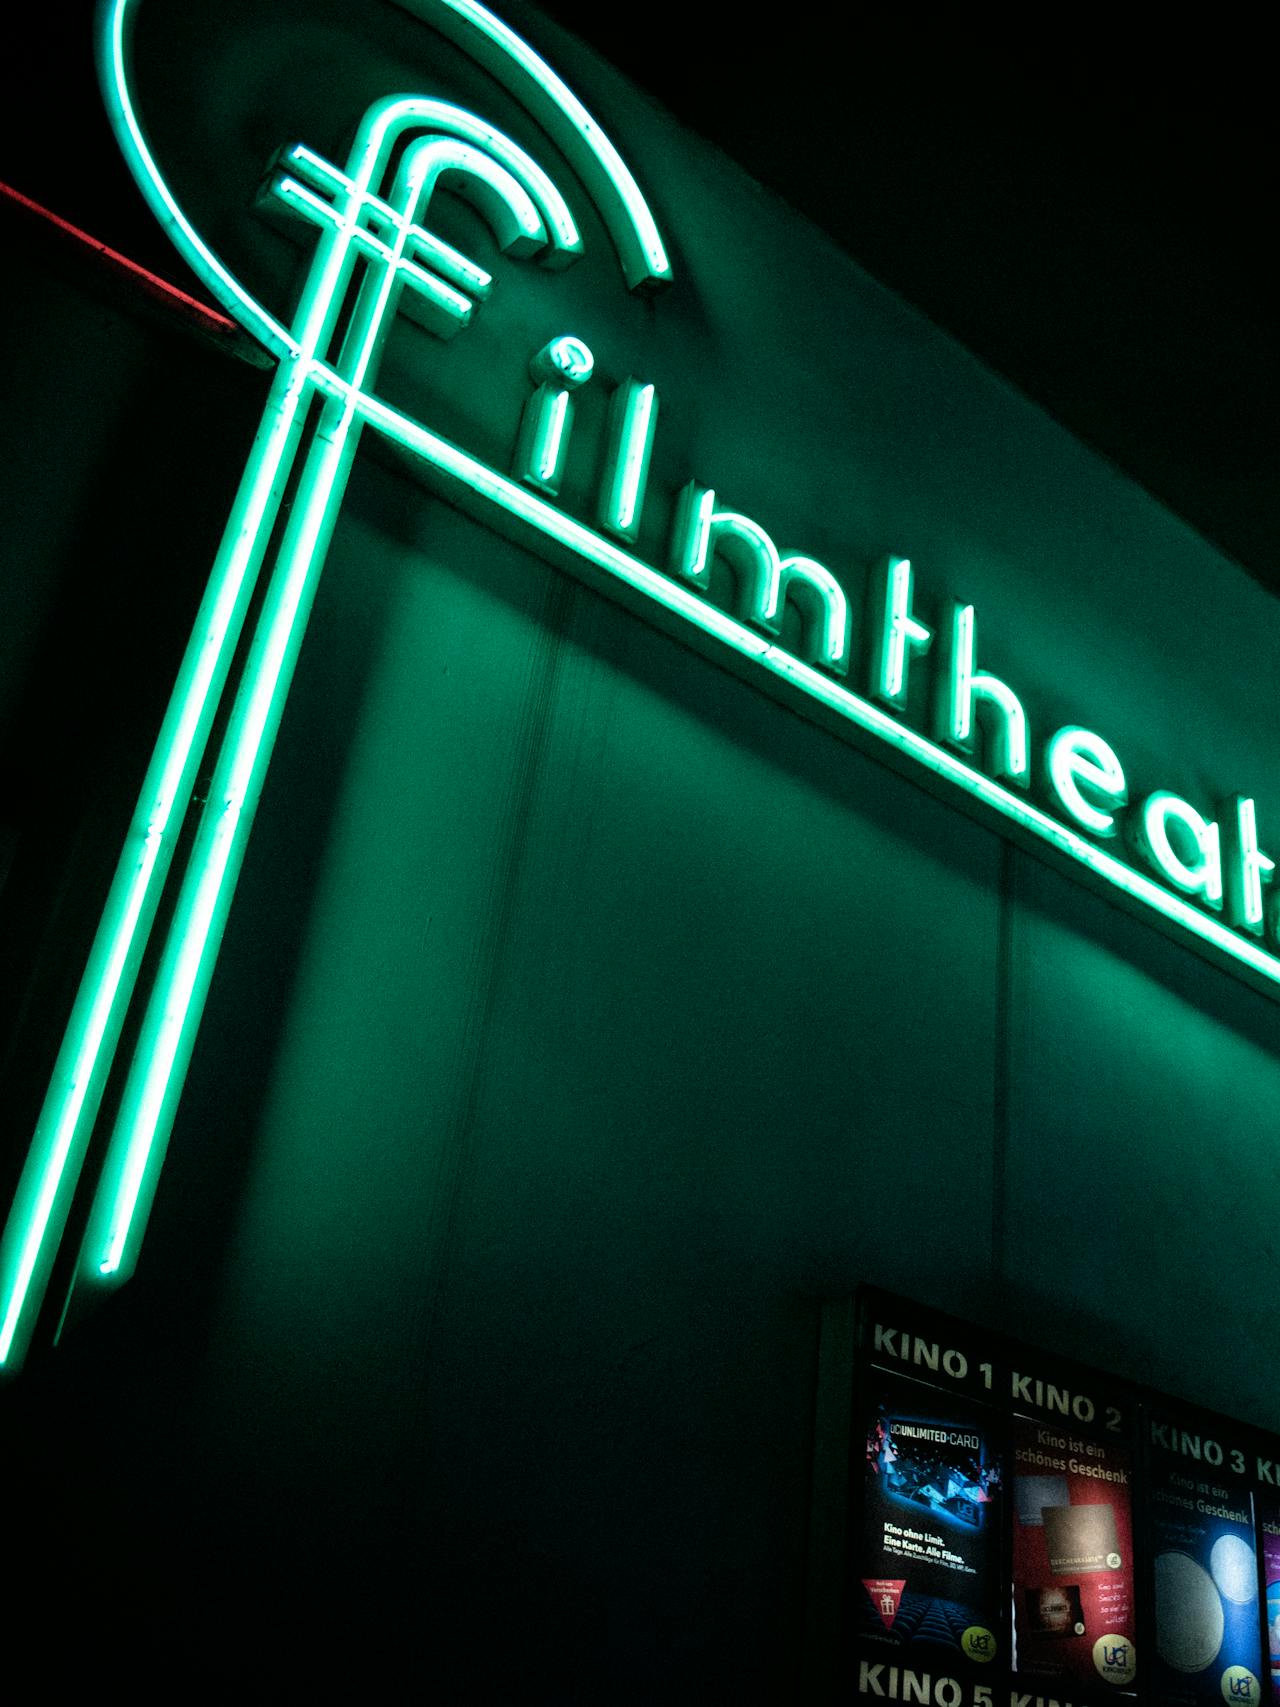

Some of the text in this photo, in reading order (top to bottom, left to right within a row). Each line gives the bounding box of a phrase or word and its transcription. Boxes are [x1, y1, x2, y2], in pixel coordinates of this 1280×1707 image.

[874, 1323, 993, 1390] KINO 1
[1011, 1371, 1122, 1433] KINO 2
[1037, 1430, 1105, 1459] Kino ist ein
[1151, 1420, 1246, 1474] KINO 3
[1015, 1447, 1067, 1472] schönes
[1196, 1499, 1250, 1524] Geschenk
[884, 1522, 903, 1536] Kino
[903, 1528, 924, 1541] ohne
[884, 1535, 902, 1548] Eine
[926, 1546, 942, 1559] Alle
[858, 1660, 962, 1707] KINO
[973, 1684, 994, 1707] 5
